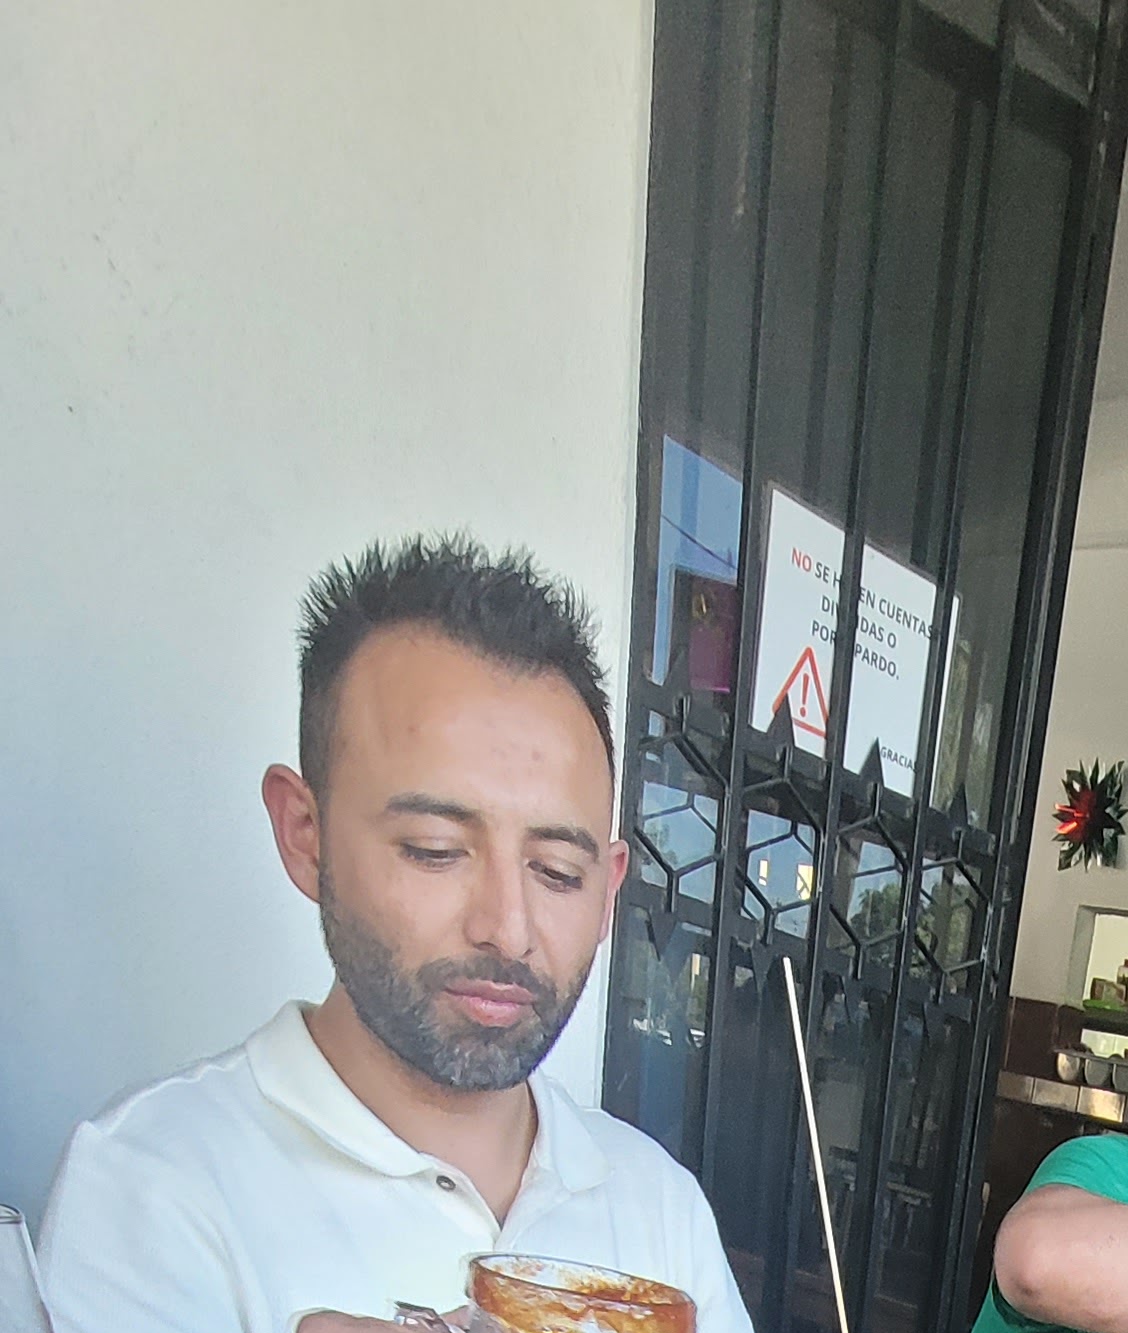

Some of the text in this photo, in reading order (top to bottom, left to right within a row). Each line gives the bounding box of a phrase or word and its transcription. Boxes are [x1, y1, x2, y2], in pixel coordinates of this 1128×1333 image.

[791, 547, 812, 573] NO
[814, 561, 831, 584] SE
[832, 570, 875, 609] HEN
[821, 595, 898, 649] DIDAS O
[880, 746, 915, 771] GRACIA
